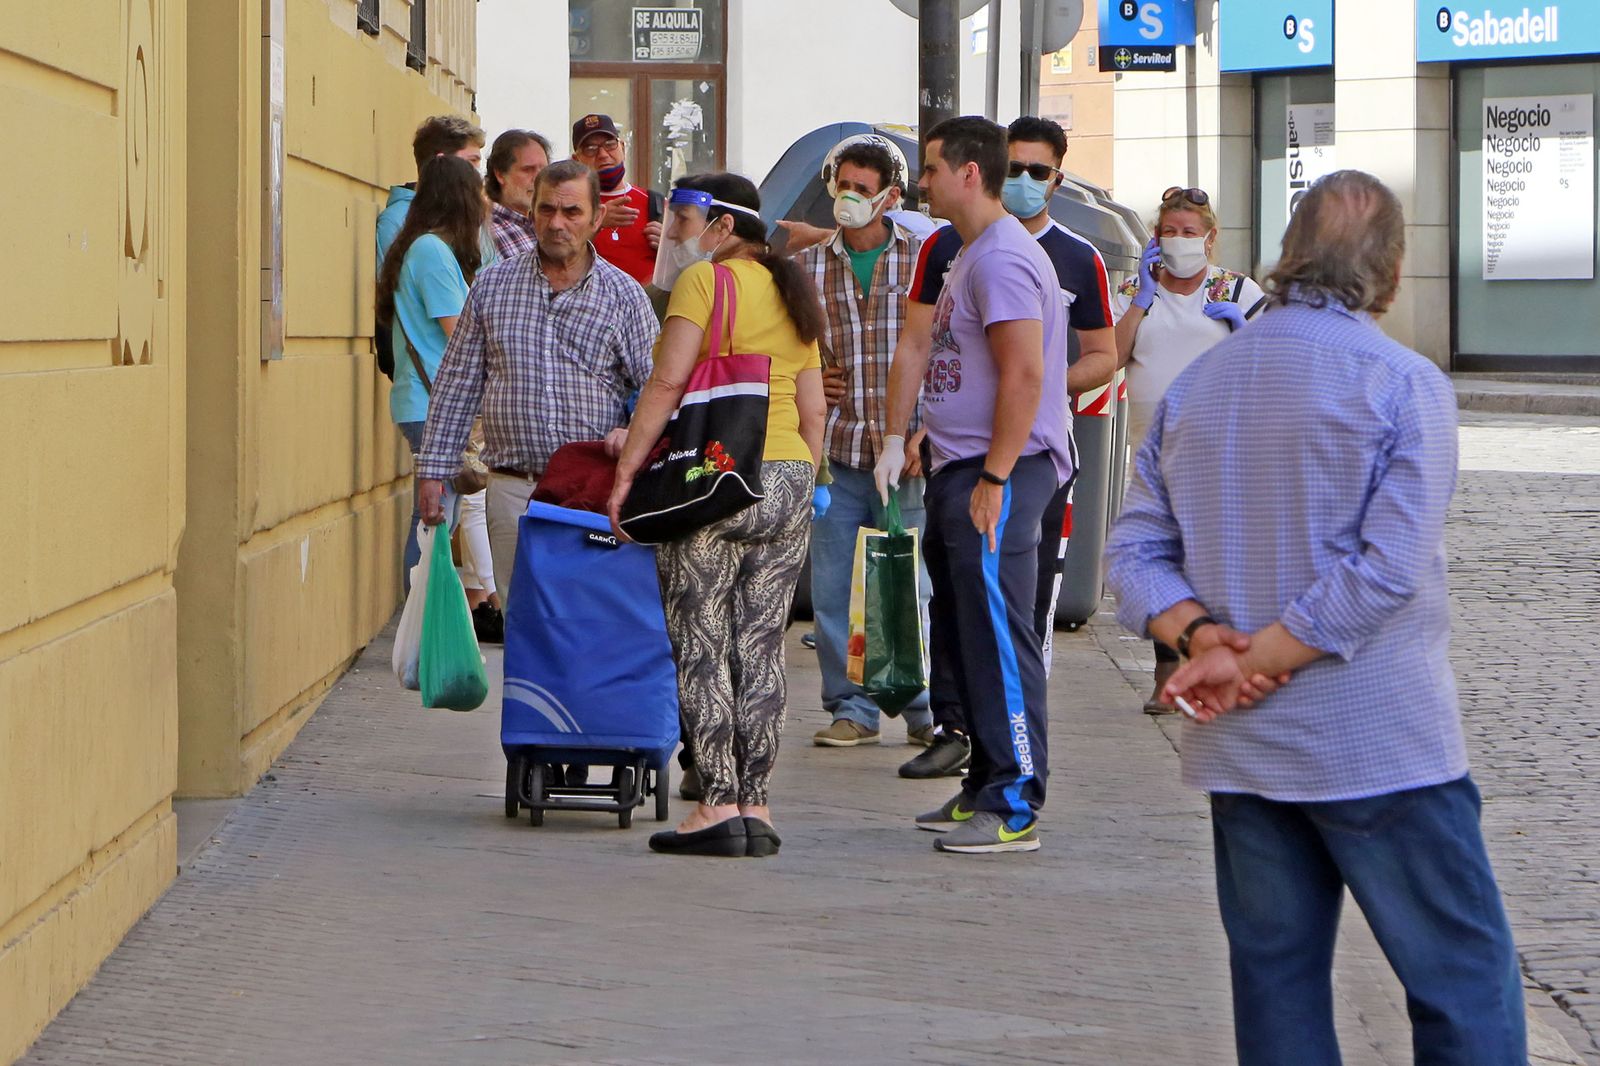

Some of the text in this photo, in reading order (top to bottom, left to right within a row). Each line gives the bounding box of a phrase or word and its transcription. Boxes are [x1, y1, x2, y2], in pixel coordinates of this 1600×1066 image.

[636, 12, 699, 29] SE ALQUILA
[1452, 6, 1558, 47] Sabadell
[1133, 52, 1172, 64] ServiRed
[1487, 103, 1551, 133] Negocio
[1487, 132, 1541, 157] Negocio
[1487, 157, 1532, 178] Negocio
[1487, 178, 1525, 195] Negocio
[1487, 195, 1519, 209] Negocio
[1487, 209, 1514, 221] Negocio
[668, 447, 698, 462] Island
[1010, 711, 1034, 776] Reebok
